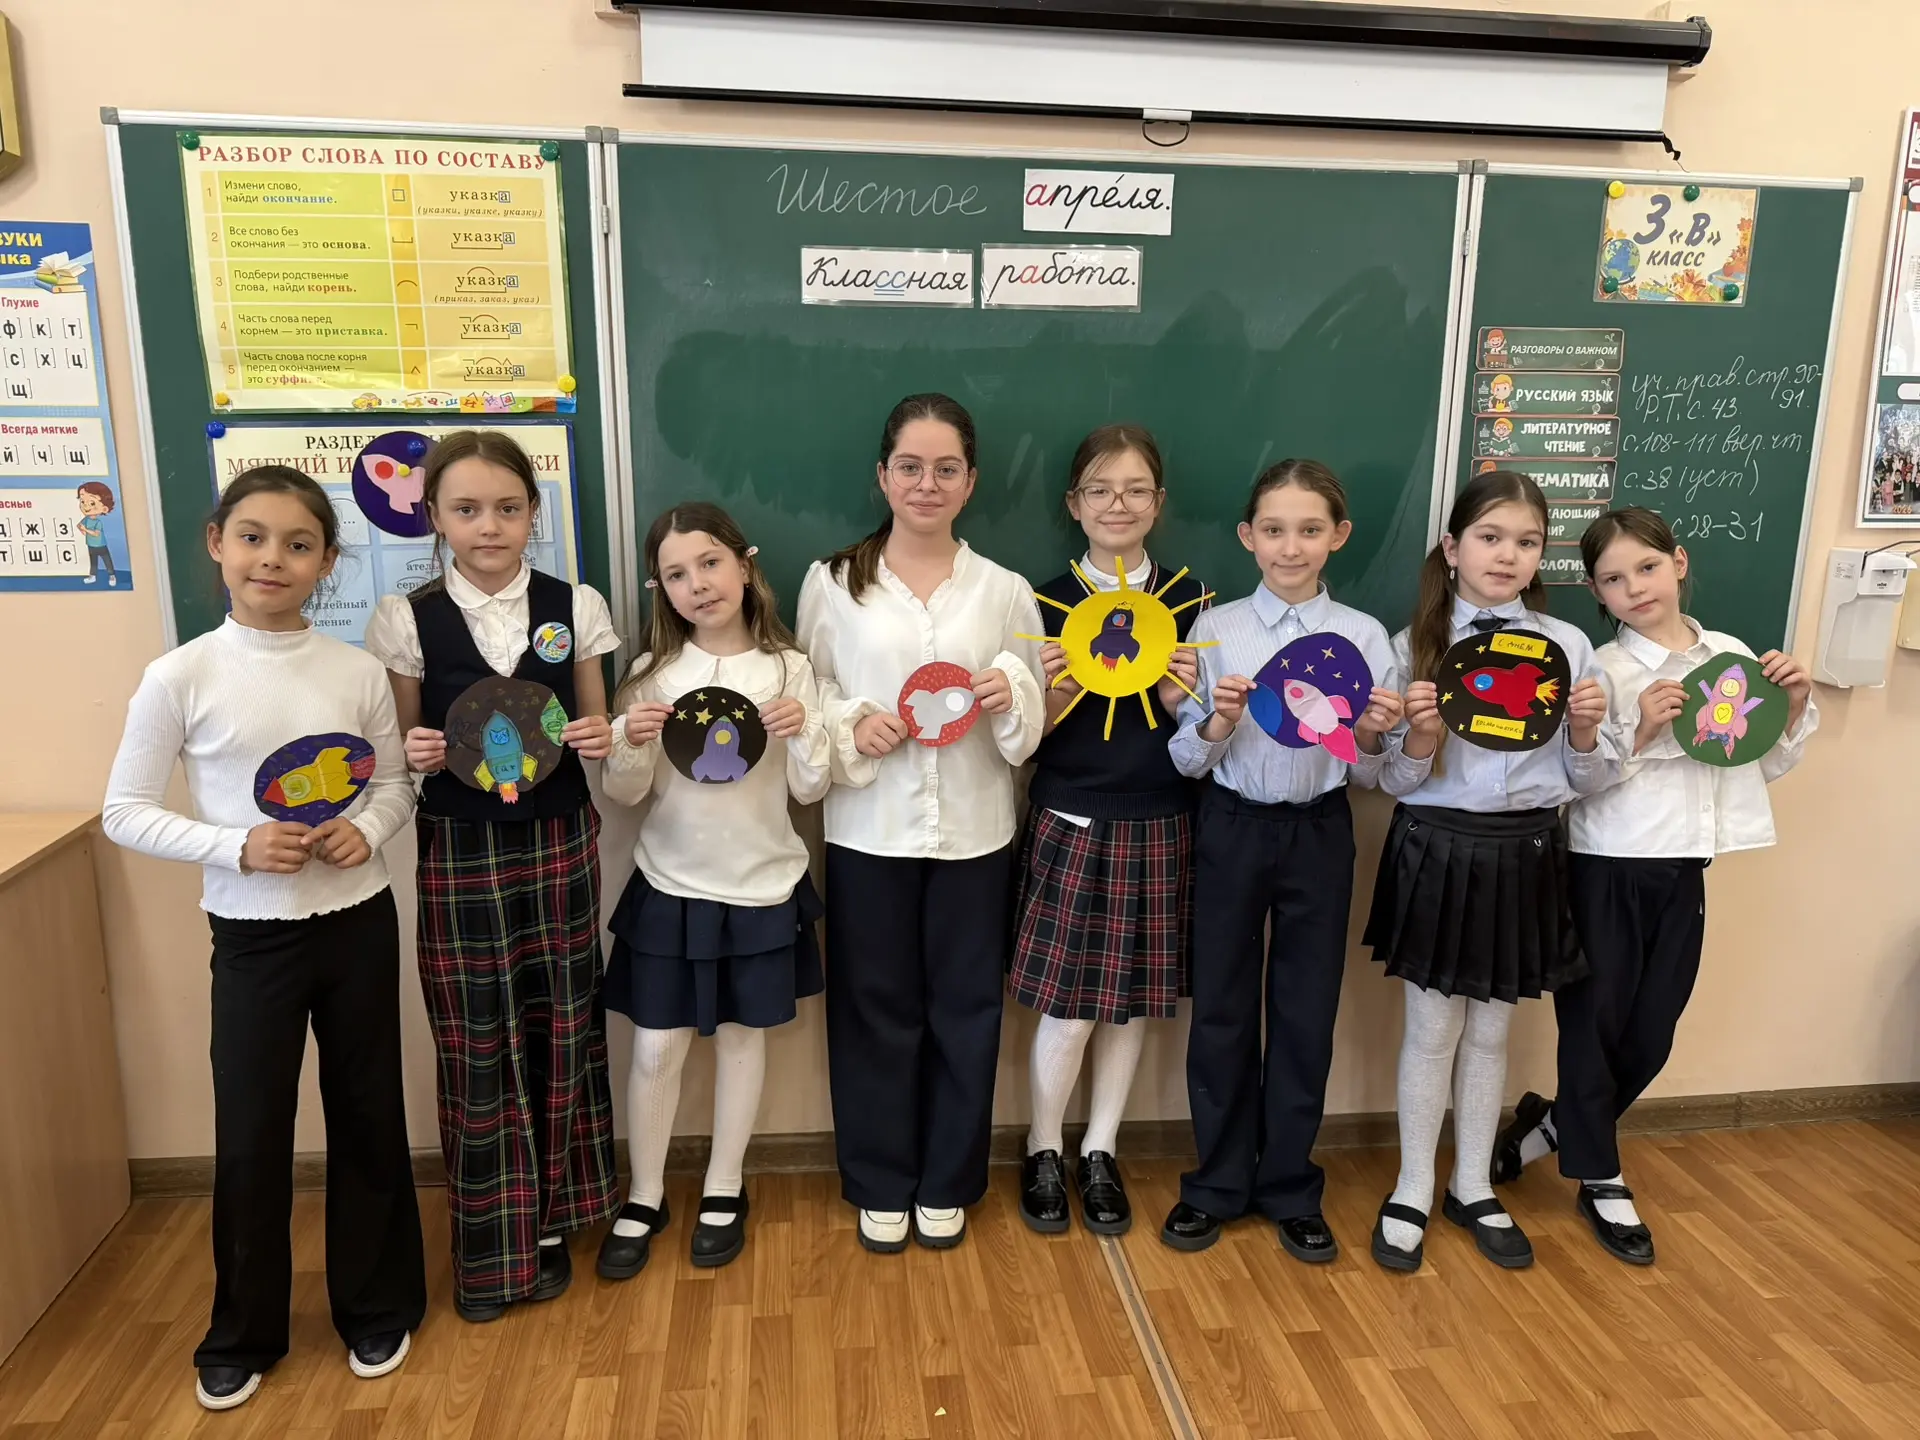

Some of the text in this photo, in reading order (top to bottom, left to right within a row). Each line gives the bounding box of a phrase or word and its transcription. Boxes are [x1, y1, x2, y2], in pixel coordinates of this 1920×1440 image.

[199, 146, 547, 170] РАЗБОР СЛОВА ПО СОСТАВУ
[224, 181, 302, 192] Измени слово,
[767, 163, 987, 217] Шестое
[226, 193, 337, 205] найди окончание.
[449, 190, 511, 203] указка
[1633, 194, 1671, 245] 3
[229, 226, 299, 236] Все слово без
[211, 232, 218, 242] 2
[452, 231, 515, 244] указка
[230, 240, 286, 249] окончания
[302, 241, 318, 249] это
[322, 241, 371, 249] основа.
[234, 270, 349, 281] Подбери родственные
[805, 256, 969, 292] Классная
[215, 277, 223, 287] 3
[457, 275, 519, 288] указка
[235, 282, 357, 294] слова, найди корень.
[2, 297, 39, 309] Глухие
[238, 314, 332, 325] Часть слова перед
[220, 321, 227, 331] 4
[462, 322, 521, 335] указка
[240, 328, 279, 336] корнем
[316, 327, 388, 338] приставка.
[1510, 345, 1617, 355] РАЗГОВОРЫ О ВАЖНОМ
[244, 353, 273, 361] Часть
[275, 353, 304, 361] слова
[228, 365, 235, 374] 5
[247, 364, 277, 373] перед
[279, 364, 340, 372] окончанием
[465, 365, 525, 377] указка
[247, 376, 263, 384] это
[1516, 389, 1615, 403] РУССКИЙ ЯЗЫК
[1, 424, 78, 435] Всегда мягкие
[1520, 422, 1612, 435] ЛИТЕРАТУРНОЕ
[1544, 440, 1586, 452] ЧТЕНИЕ
[1522, 473, 1609, 488] ТЕМАТИКА
[1548, 525, 1565, 536] ИР
